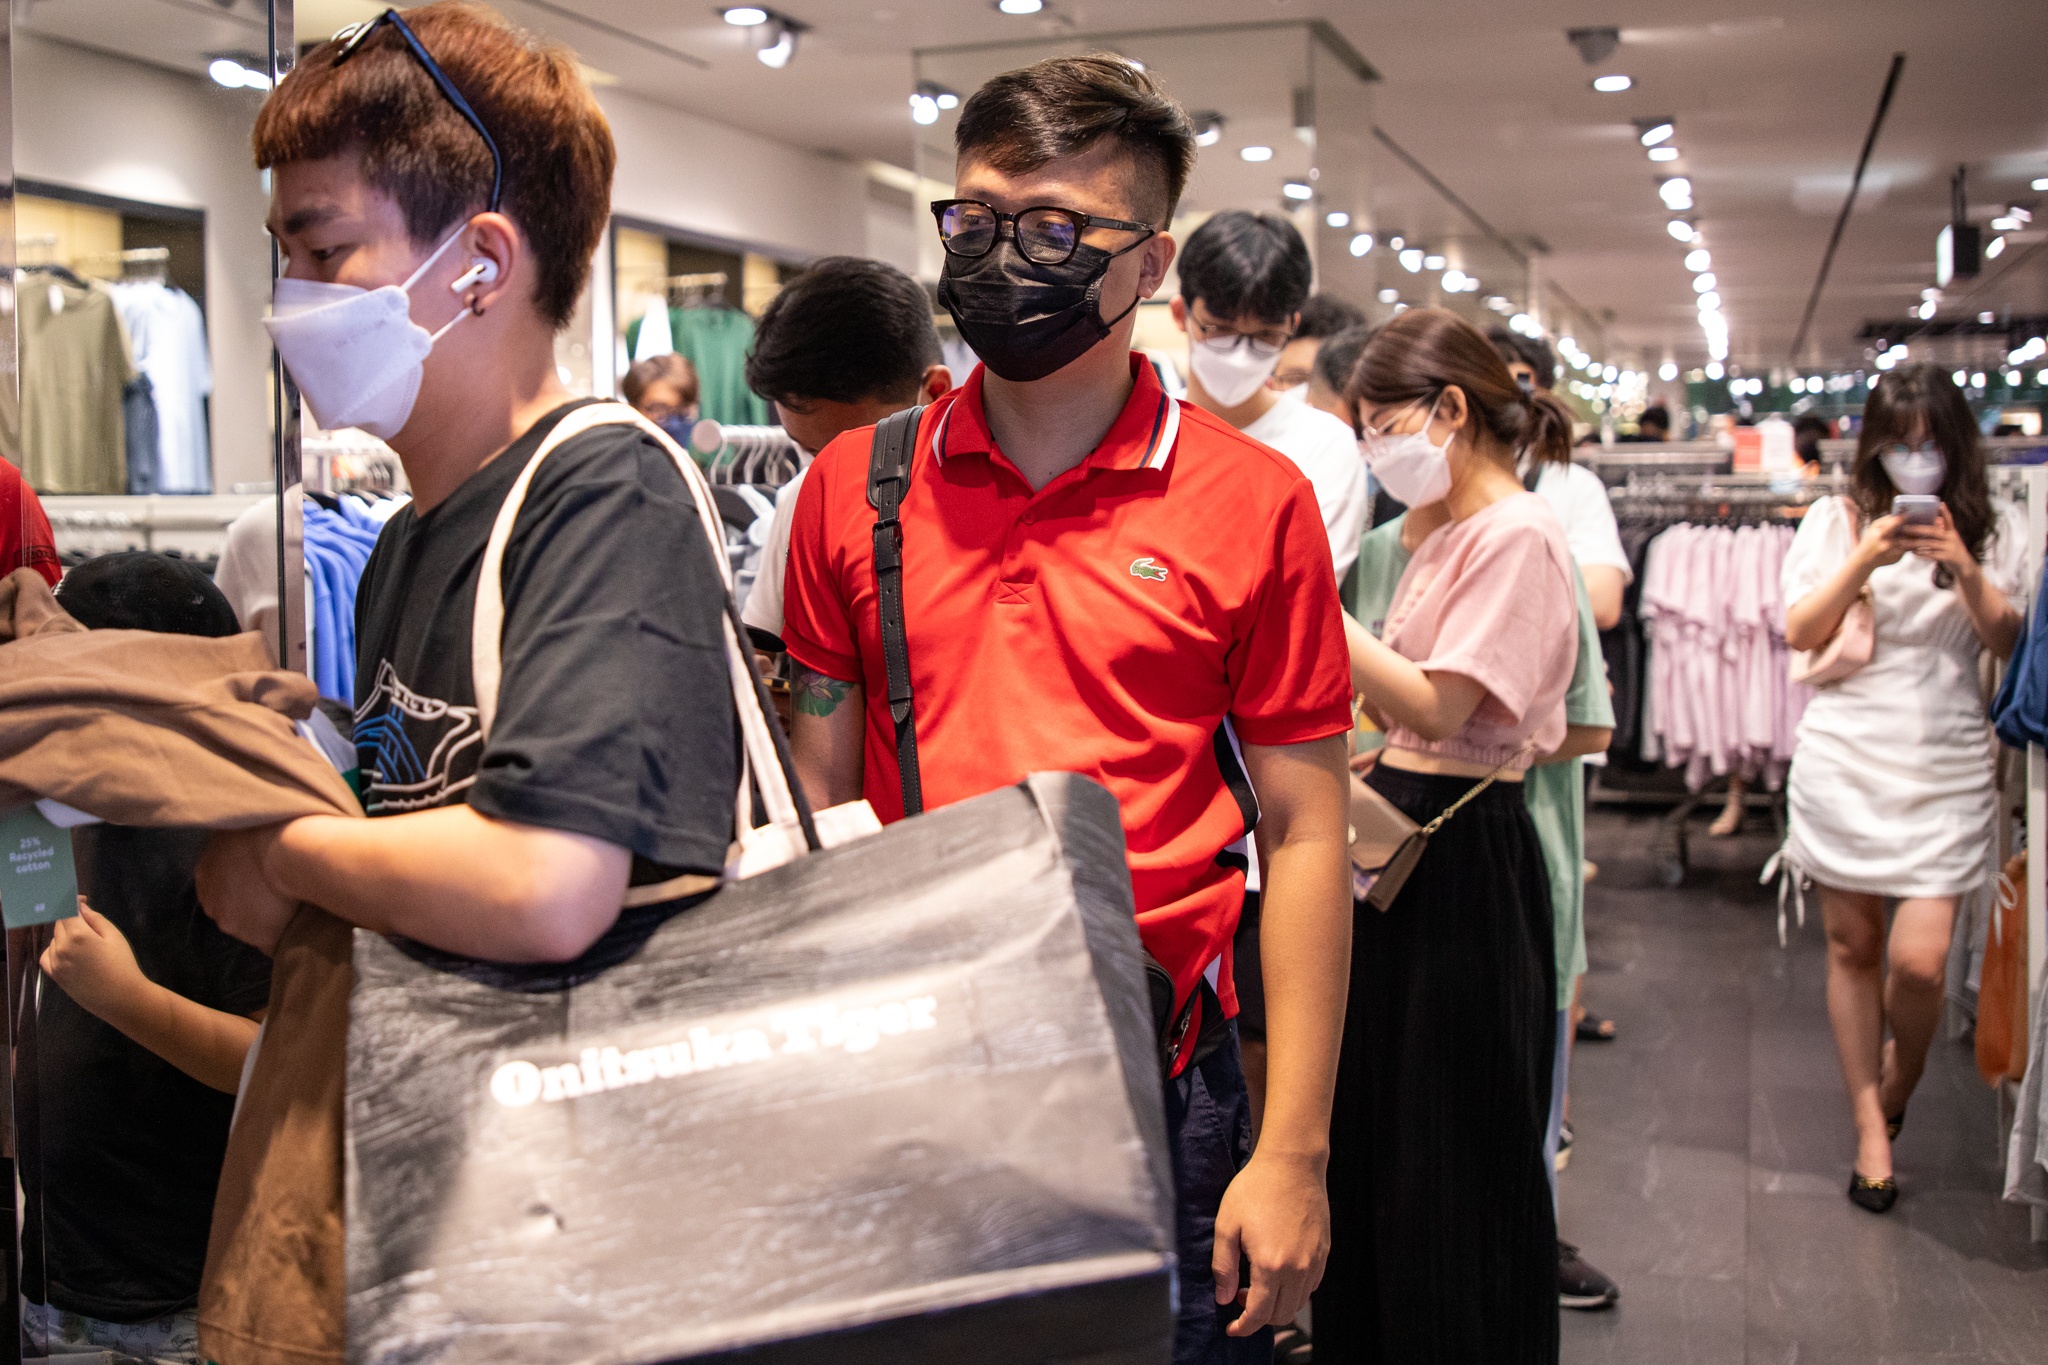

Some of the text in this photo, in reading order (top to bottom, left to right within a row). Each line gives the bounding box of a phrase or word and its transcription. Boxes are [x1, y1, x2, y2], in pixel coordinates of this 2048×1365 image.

[20, 837, 41, 849] 25%
[9, 847, 54, 862] Recycled
[15, 861, 51, 874] cotton
[490, 996, 938, 1107] Onitsuka Tiger
